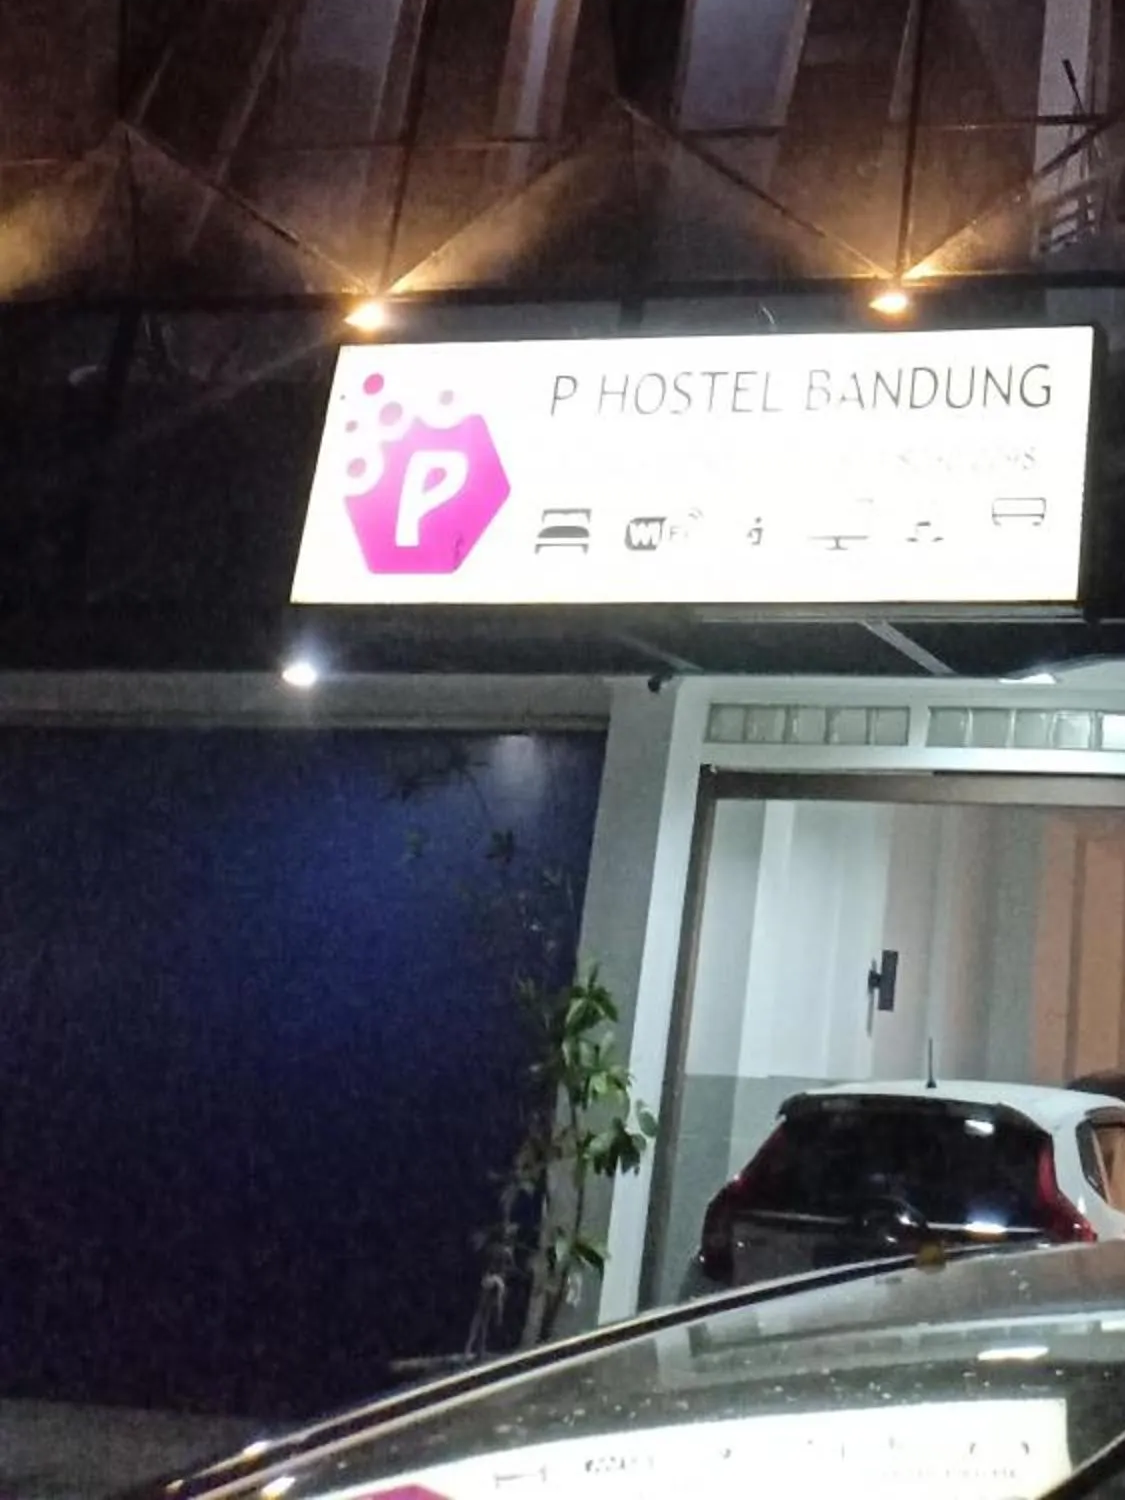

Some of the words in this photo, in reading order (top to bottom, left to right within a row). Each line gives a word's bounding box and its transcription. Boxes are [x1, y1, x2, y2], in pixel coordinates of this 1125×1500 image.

[549, 374, 580, 417] P
[597, 369, 784, 416] HOSTEL
[803, 362, 1053, 412] BANDUNG
[395, 450, 469, 548] P
